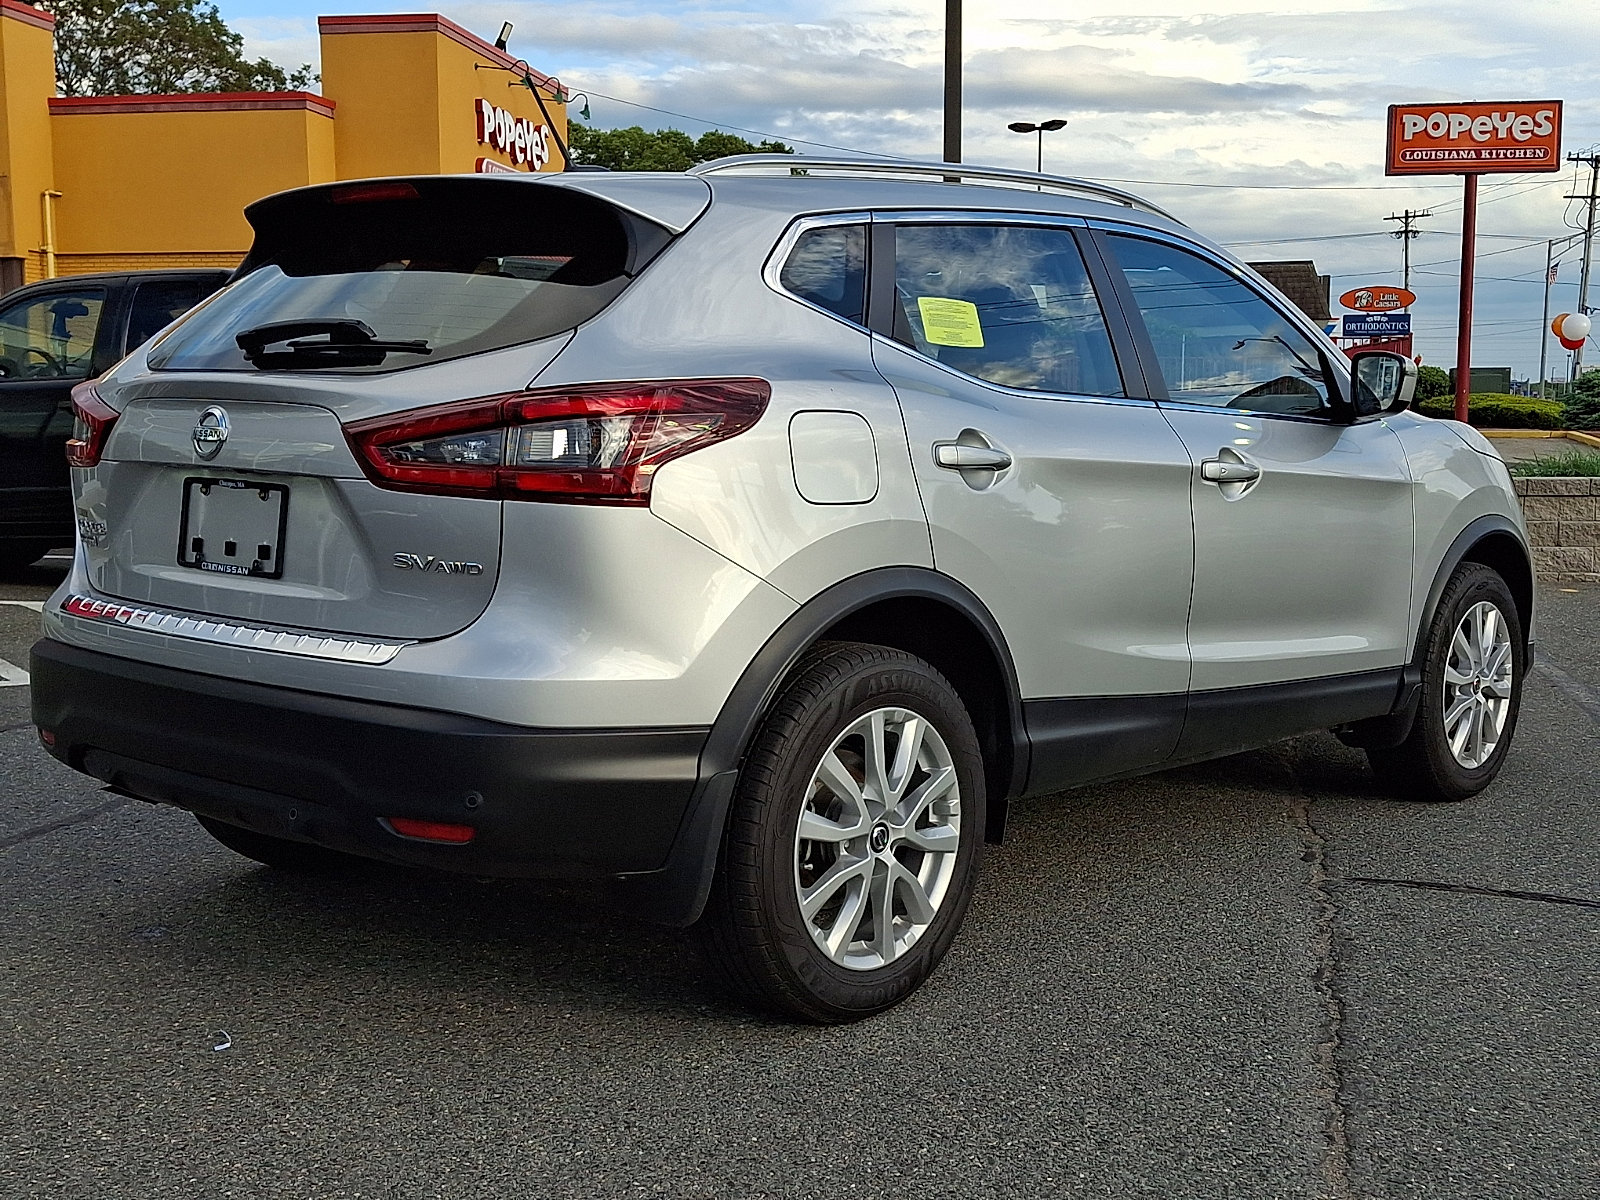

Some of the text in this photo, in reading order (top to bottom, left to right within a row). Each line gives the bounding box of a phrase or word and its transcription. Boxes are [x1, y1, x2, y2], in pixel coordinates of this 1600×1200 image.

[1405, 149, 1545, 160] LOUISIANA KITCHEN
[1380, 292, 1399, 301] Little
[1373, 300, 1401, 308] Caesars
[1345, 322, 1409, 331] ORTHODONTICS
[393, 552, 484, 576] SV AWD
[218, 564, 249, 576] NISSAN
